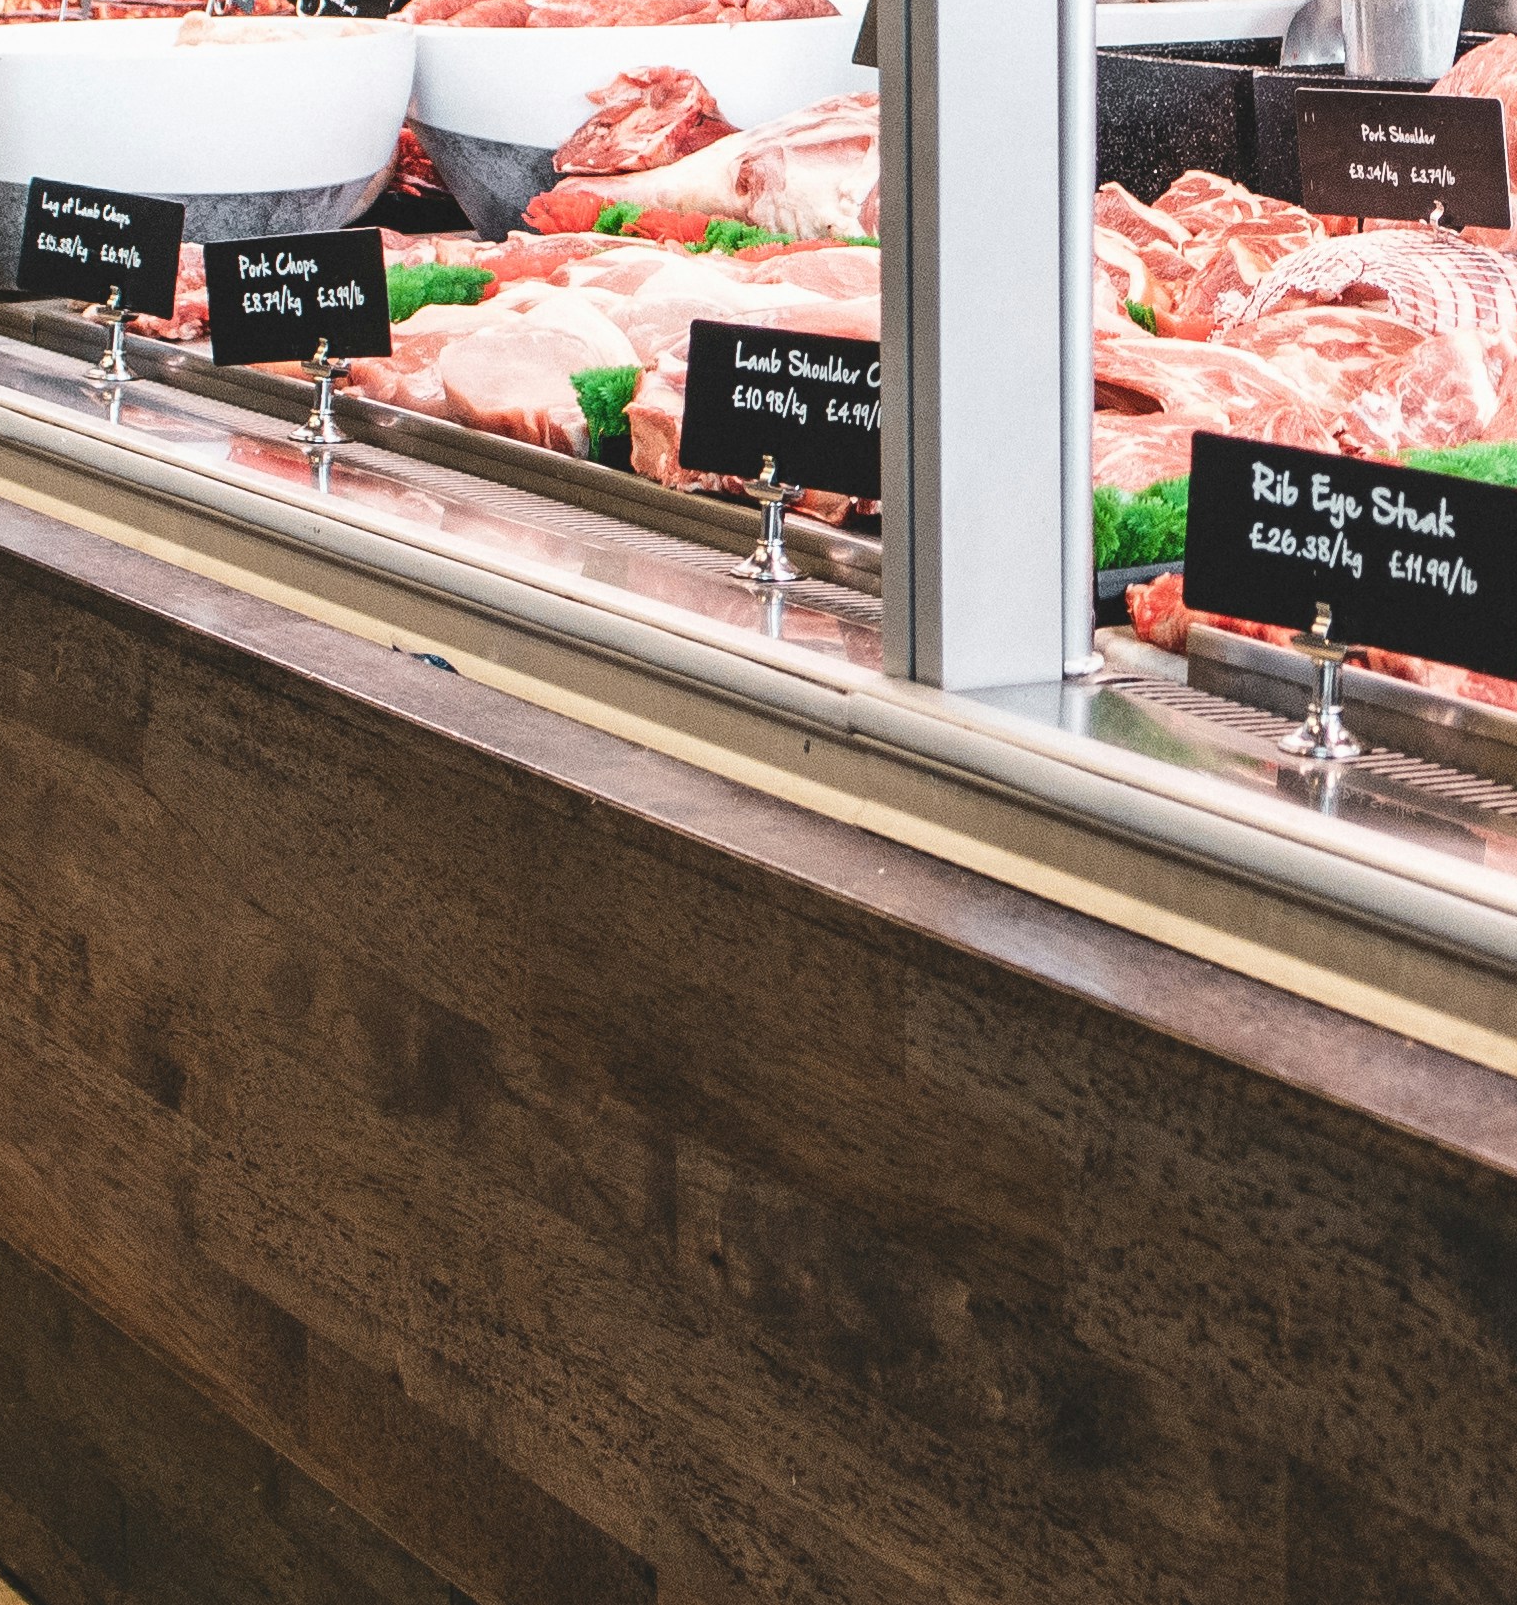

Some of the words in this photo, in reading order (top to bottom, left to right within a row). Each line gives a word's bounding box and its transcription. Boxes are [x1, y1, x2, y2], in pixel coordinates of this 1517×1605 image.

[1360, 123, 1387, 142] Pork
[1388, 125, 1436, 145] Shoulder
[1410, 164, 1456, 188] £3.79/lb
[41, 191, 60, 218] Leg
[62, 197, 75, 214] of
[75, 197, 101, 220] Lamb
[102, 204, 132, 230] Chops
[238, 252, 273, 280] Pork
[275, 252, 319, 282] Chops
[242, 284, 303, 318] £8.79/kg
[317, 279, 366, 311] £3.99/lb
[735, 340, 782, 375] Lamb
[788, 349, 861, 385] Shoulder
[731, 384, 808, 426] £10.98/kg
[1251, 460, 1299, 508] Rib
[1310, 472, 1363, 530] Eye
[1371, 485, 1457, 539] Steak
[1248, 521, 1364, 580] £26.38/kg
[1388, 549, 1479, 596] £11.99/lb
